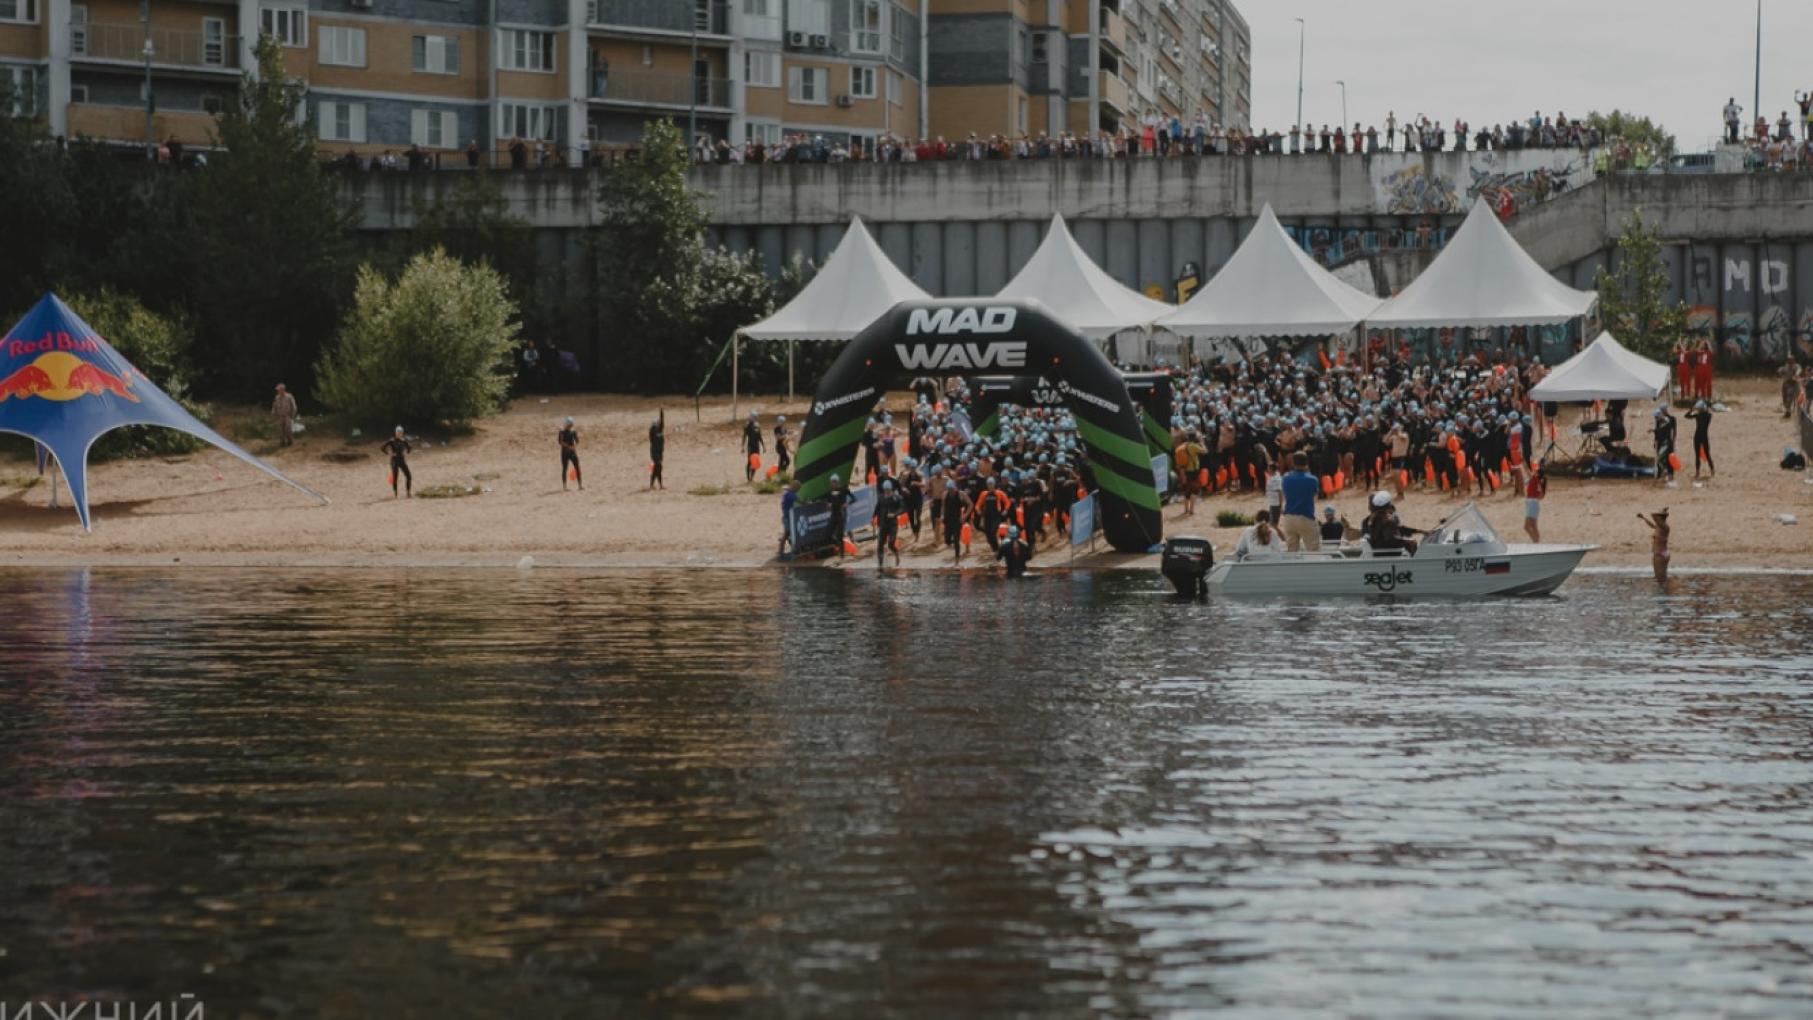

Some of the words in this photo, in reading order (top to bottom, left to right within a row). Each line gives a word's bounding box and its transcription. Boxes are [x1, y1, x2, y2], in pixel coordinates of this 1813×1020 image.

[906, 306, 1017, 335] MAD
[9, 331, 53, 358] Red
[894, 341, 1028, 370] WAVE
